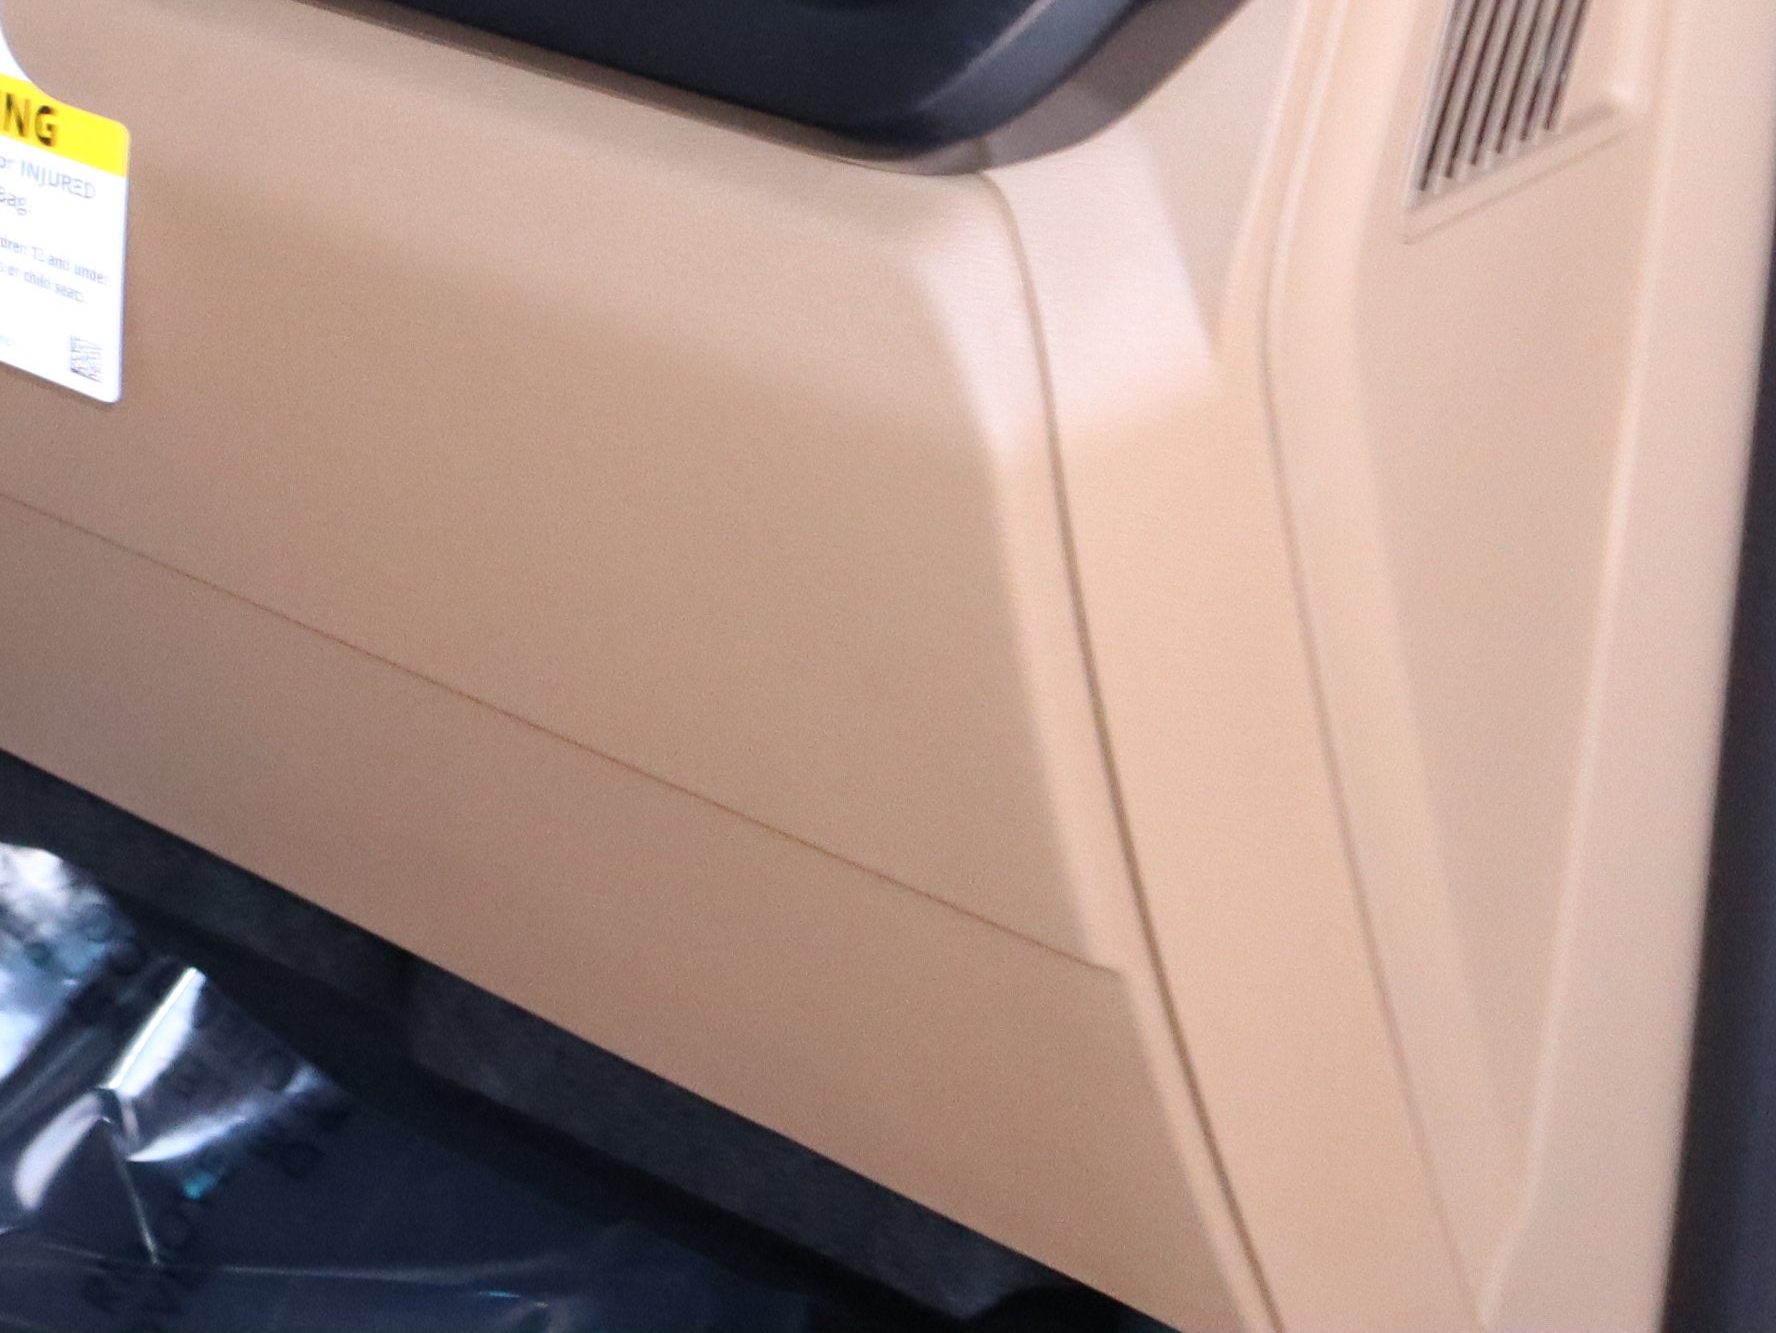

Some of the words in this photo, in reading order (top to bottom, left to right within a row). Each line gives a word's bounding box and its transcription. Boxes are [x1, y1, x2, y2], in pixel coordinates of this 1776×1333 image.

[21, 159, 96, 201] INJURED
[7, 262, 21, 279] or
[23, 266, 52, 291] child
[48, 254, 70, 273] and
